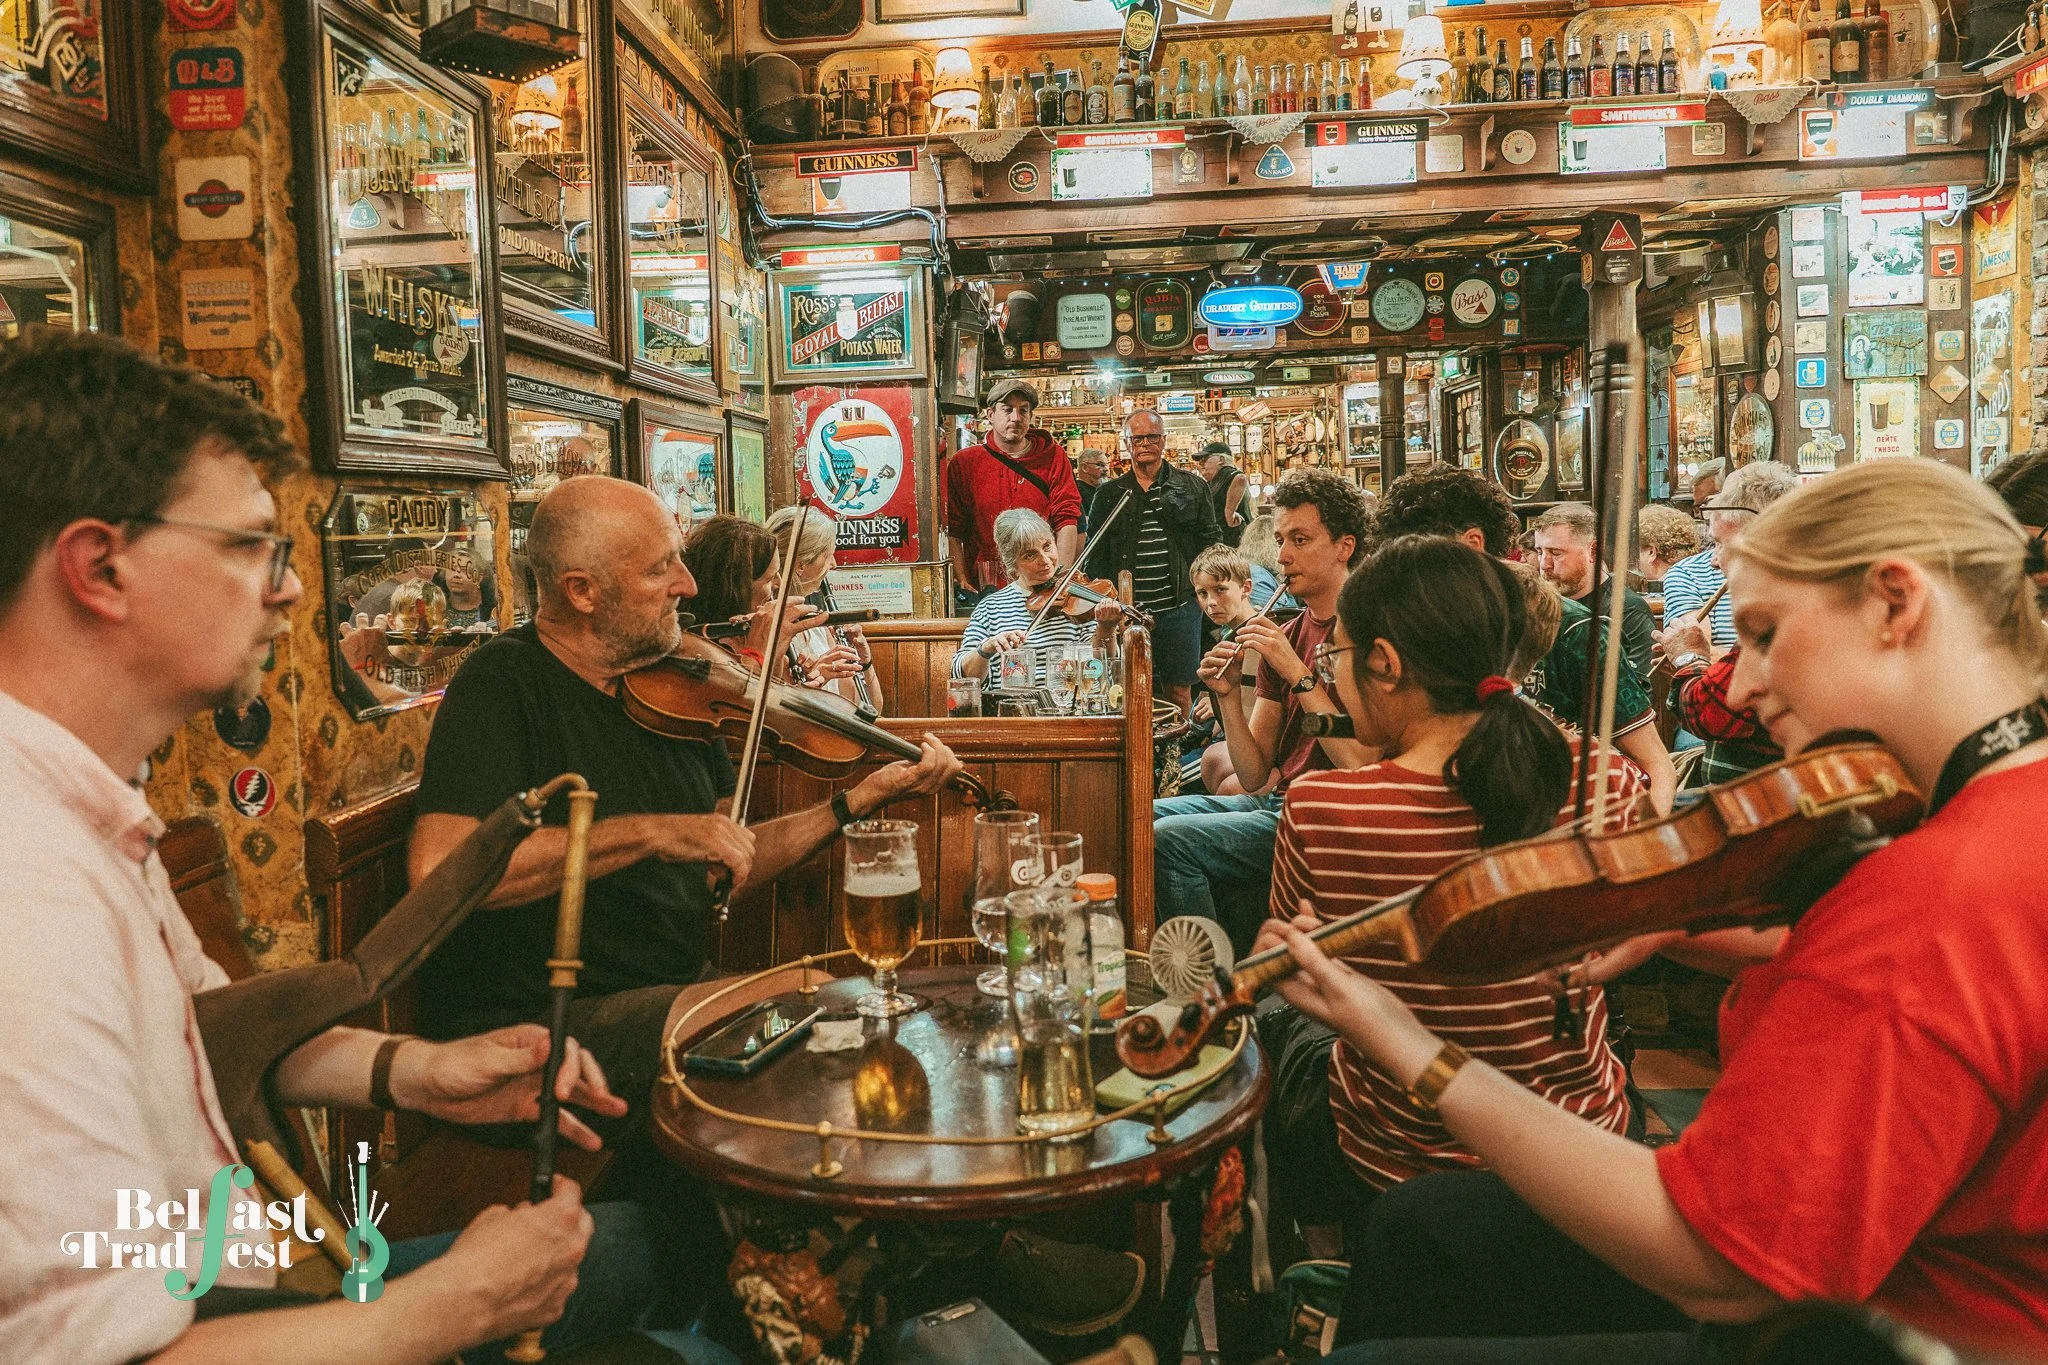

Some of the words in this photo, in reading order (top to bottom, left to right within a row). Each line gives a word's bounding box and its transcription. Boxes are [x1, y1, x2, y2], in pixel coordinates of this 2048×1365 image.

[1129, 21, 1153, 31] GUINNESS
[880, 70, 928, 83] GUINNS
[1754, 91, 1780, 106] Bass
[1850, 95, 1884, 106] DOUBLE
[1887, 92, 1928, 104] DIAMOND
[1256, 115, 1281, 128] Bass
[1601, 109, 1678, 122] SMITHWICK'S
[1357, 124, 1418, 137] GUINNESS
[977, 132, 1002, 146] Bass
[1084, 133, 1158, 148] SMITHWICK'S
[1388, 134, 1417, 143] goodness
[813, 152, 899, 173] GUINNESS
[1261, 166, 1292, 175] TANKARD
[499, 224, 574, 273] ONDONDERRY.
[1606, 236, 1628, 248] Bass
[1334, 264, 1363, 275] HARP
[1979, 249, 2011, 276] JAMESON
[1454, 287, 1489, 311] Bass
[791, 295, 836, 329] ROSS'S
[859, 292, 899, 327] BELFAST
[1205, 303, 1246, 313] DRAUGHT
[1249, 300, 1297, 312] GUINNESS
[794, 325, 838, 361] ROYAL
[840, 339, 873, 356] POTASS
[873, 338, 902, 355] WATER
[1876, 435, 1898, 443] ПЕЙТЕ
[386, 497, 450, 529] PADDY
[834, 518, 900, 535] INNESS
[836, 536, 857, 545] ood
[860, 534, 878, 545] for
[878, 534, 900, 547] you
[357, 557, 394, 594] CORK
[394, 549, 466, 574] DISTILLERIES
[829, 582, 864, 591] GUINNESS
[364, 653, 395, 684] OLD
[399, 666, 436, 691] IRISH
